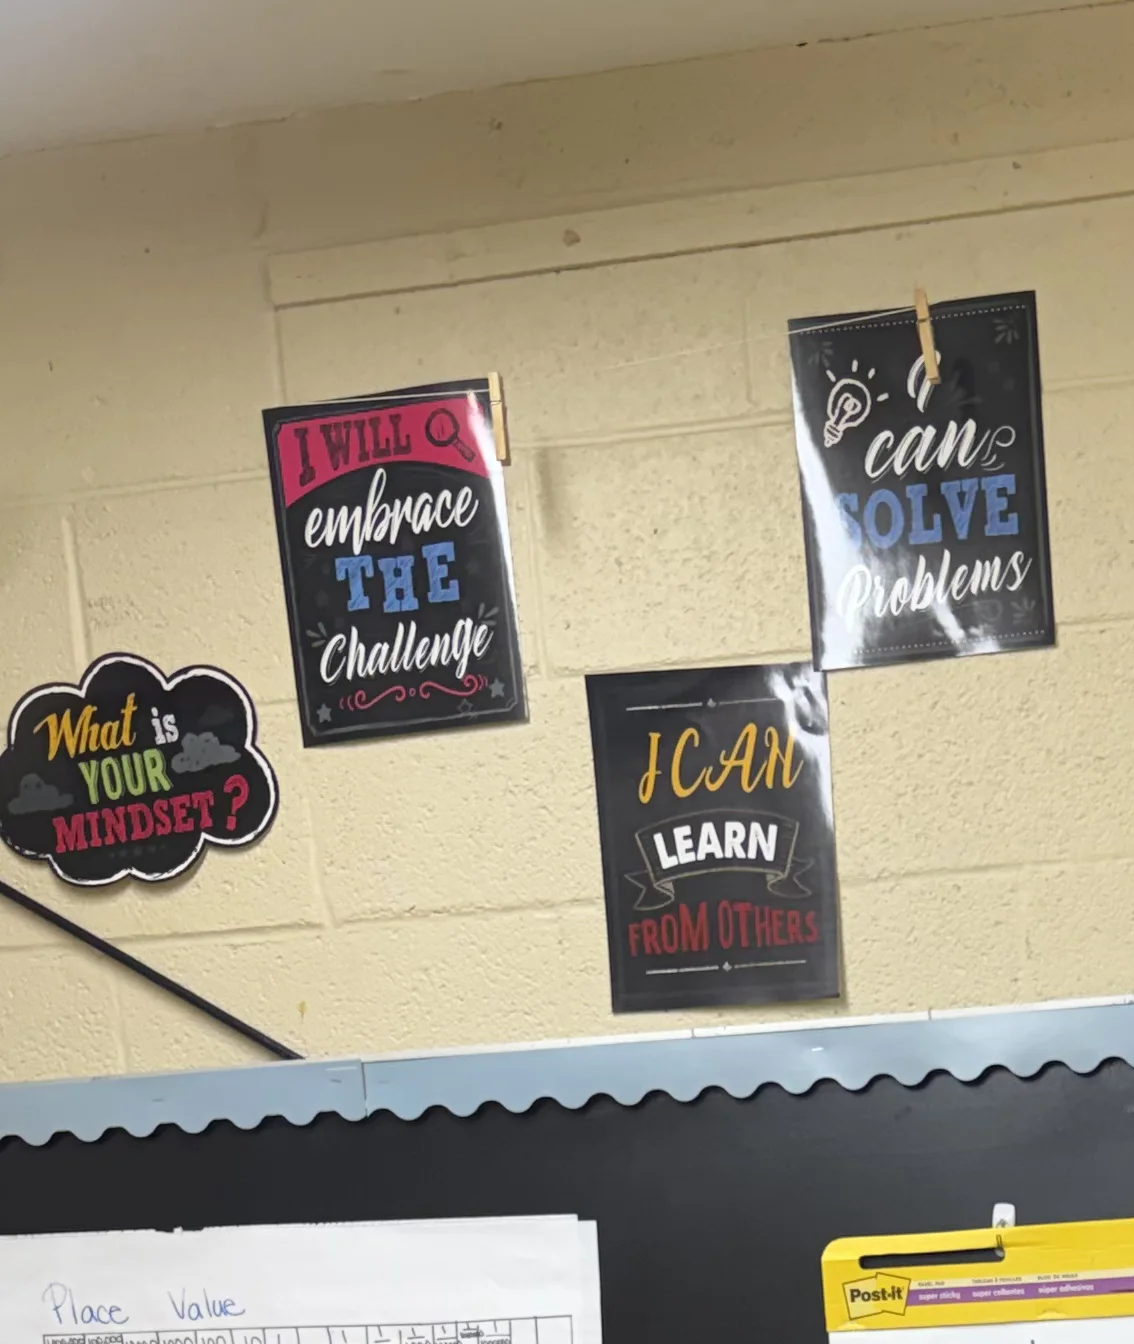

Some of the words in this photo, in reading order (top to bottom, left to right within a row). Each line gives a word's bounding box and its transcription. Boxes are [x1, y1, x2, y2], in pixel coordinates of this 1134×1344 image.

[297, 426, 318, 487] I
[319, 413, 412, 472] WILL
[864, 417, 990, 481] can
[304, 468, 480, 556] embrace
[834, 473, 1020, 550] SOLVE
[336, 540, 460, 613] THE
[836, 547, 1033, 630] Problems
[319, 614, 493, 684] Challenge
[33, 692, 138, 762] What
[151, 707, 180, 746] is
[77, 746, 174, 805] YOUR
[638, 731, 662, 806] I
[671, 722, 807, 799] CAN
[652, 819, 779, 870] LEARN
[628, 902, 709, 958] FROM
[718, 900, 820, 952] OTHERS
[42, 1281, 130, 1326] Place
[167, 1286, 247, 1322] Value
